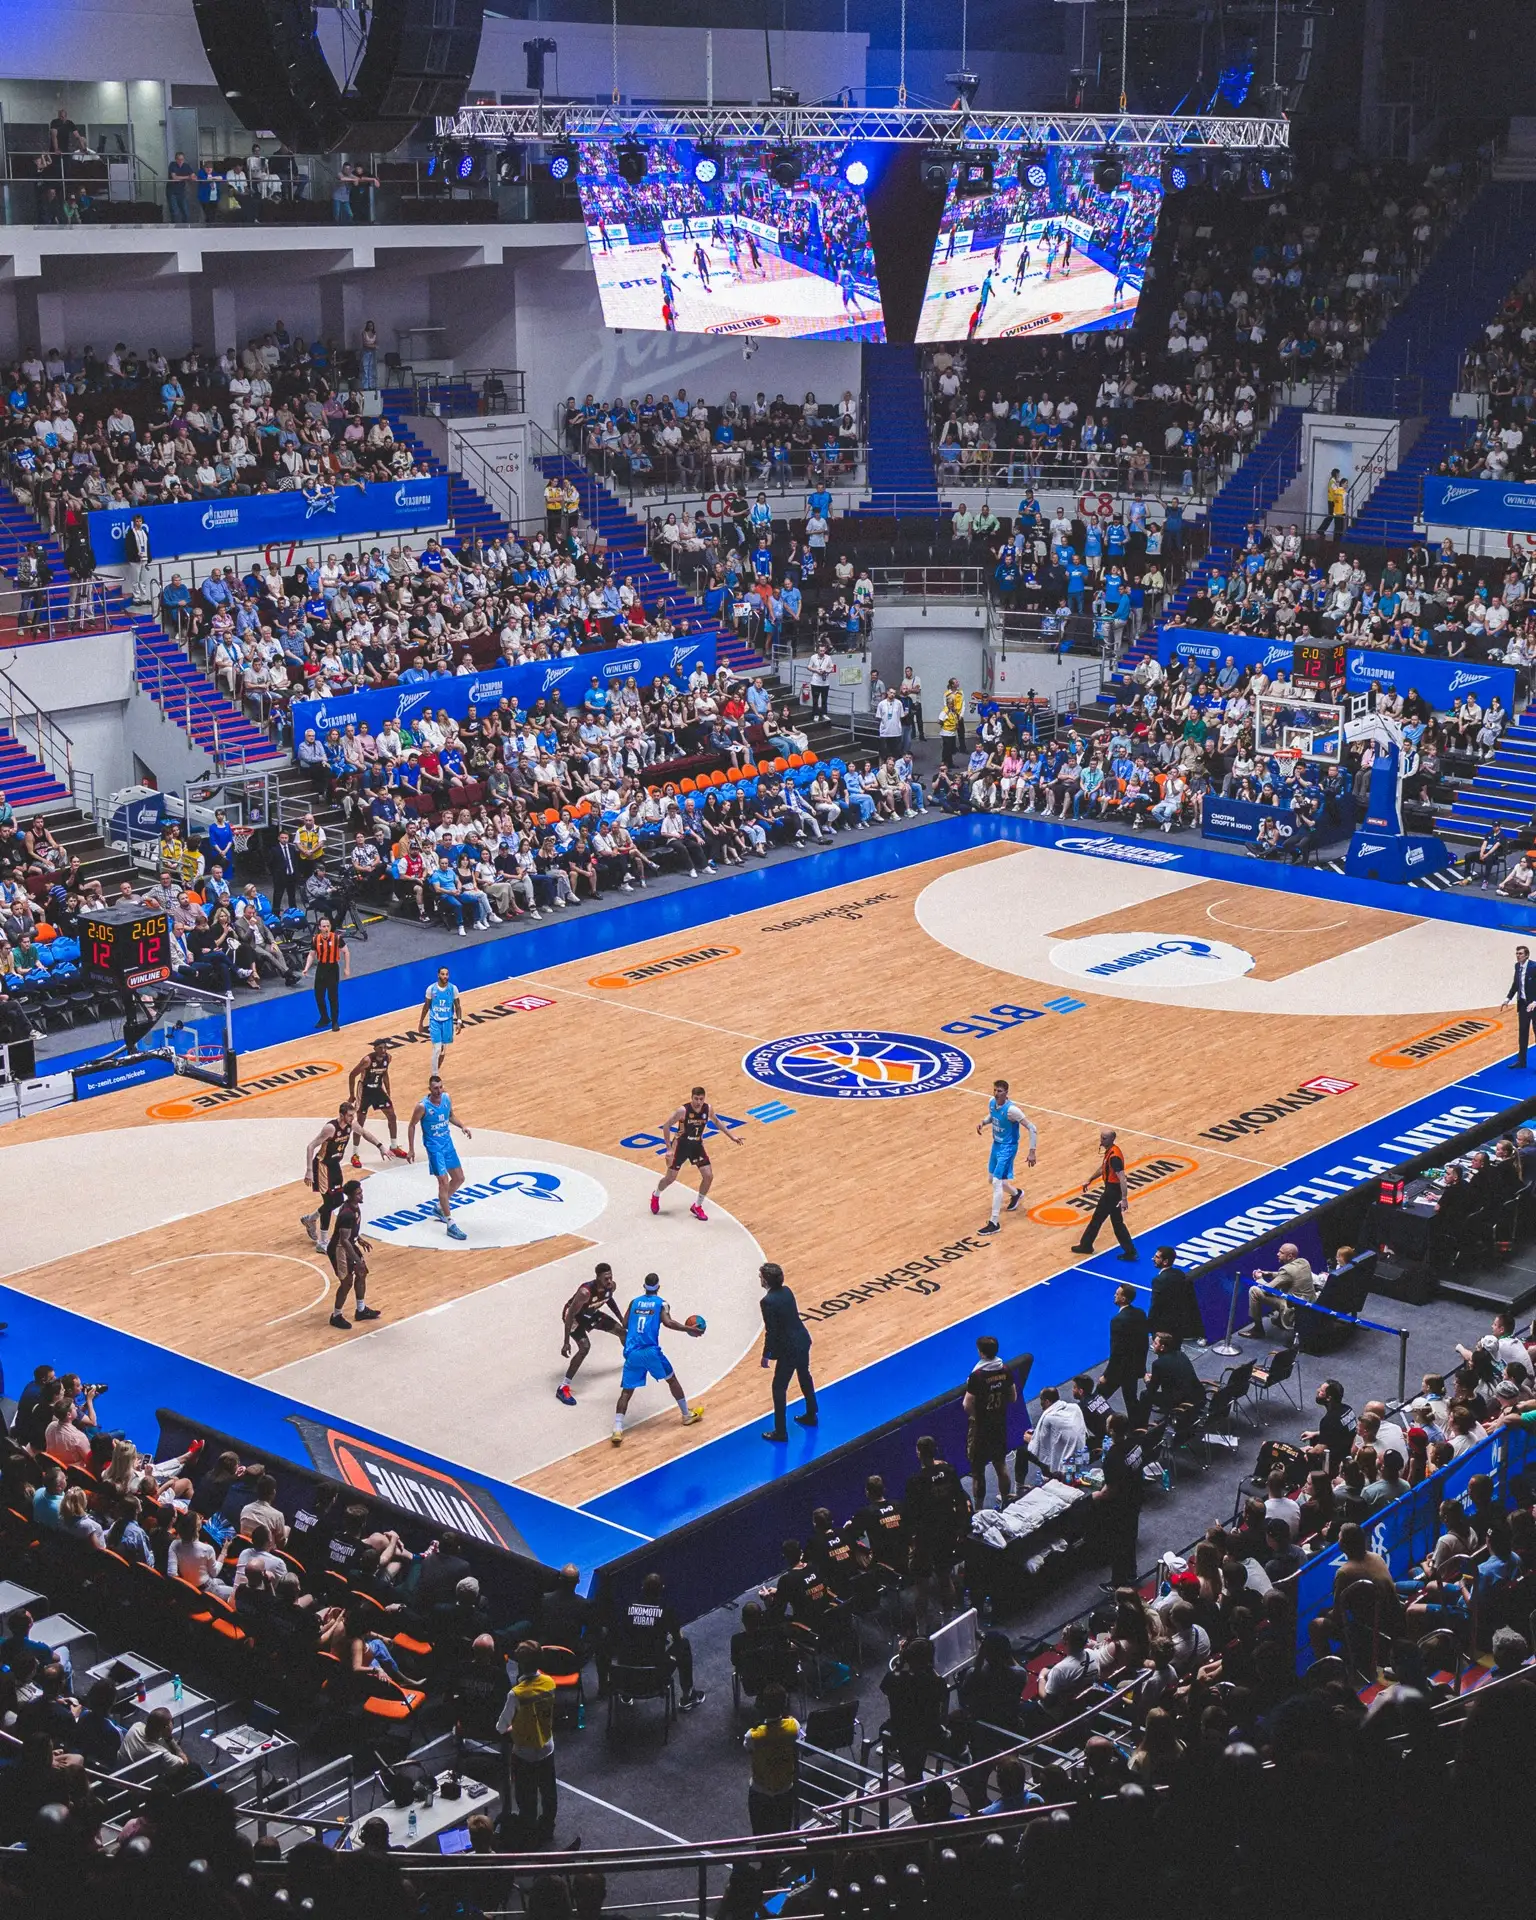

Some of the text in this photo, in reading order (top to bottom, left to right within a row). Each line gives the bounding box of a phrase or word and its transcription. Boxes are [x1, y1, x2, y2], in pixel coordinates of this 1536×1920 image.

[711, 318, 764, 335] WINLINE
[1005, 316, 1050, 337] WINLINE
[405, 495, 431, 506] ГАЗПРОМ
[1180, 646, 1211, 656] WINLINE
[606, 663, 633, 675] WINLINE
[1305, 660, 1321, 677] 12
[1363, 668, 1395, 680] ГАЗПРОМ
[327, 712, 357, 728] ГАЗПРОМ
[1211, 813, 1235, 822] СМОТРИ
[1211, 819, 1230, 828] СПОРТ
[1235, 823, 1253, 831] КИНО
[761, 892, 898, 932] ЗАРУБЕЖНЕФТЬ
[88, 922, 114, 943] 2:05
[132, 916, 167, 940] 2:05
[92, 943, 111, 968] 12
[138, 938, 161, 965] 12
[1085, 947, 1165, 976] ГАЗПРОМ
[623, 947, 729, 980] WINLINE
[130, 970, 161, 986] WINLINE
[940, 1003, 1046, 1039] ВТБ
[1400, 1020, 1489, 1060] WINLINE
[751, 1032, 880, 1077] VTB UNITED LEAGUE
[87, 1069, 146, 1091] bc-zenit.com/tickets
[838, 1051, 966, 1098] ЕДИНАЯ ЛИГА ВТБ
[192, 1065, 329, 1108] WINLINE
[1198, 1087, 1328, 1142] ЛУКОЙЛ
[365, 1461, 494, 1545] WINLINE
[628, 1606, 663, 1618] LOKOMOTIV
[633, 1615, 655, 1626] KUBAN
